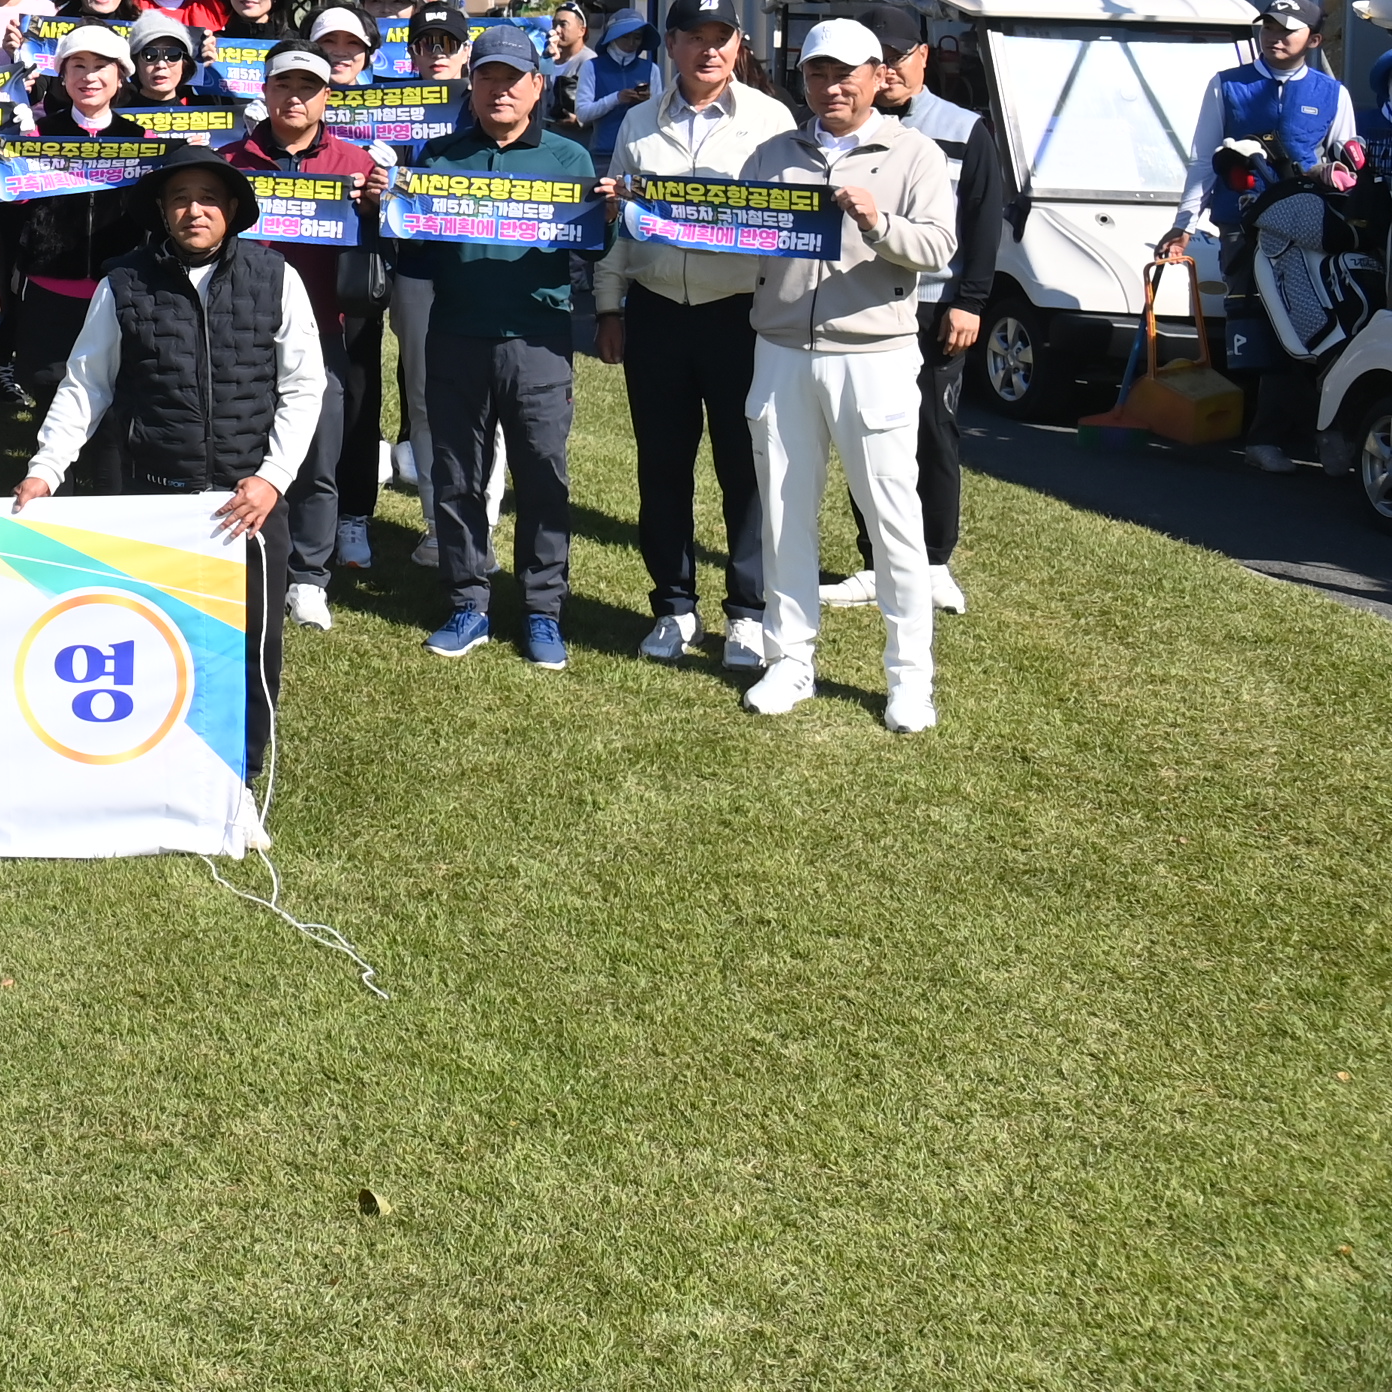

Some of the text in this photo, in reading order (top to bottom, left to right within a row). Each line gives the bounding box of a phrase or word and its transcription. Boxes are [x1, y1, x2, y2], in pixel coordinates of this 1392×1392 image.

[355, 107, 425, 122] 국가철도망
[3, 141, 166, 158] 사천우주항공철도!
[408, 172, 581, 204] 사천우주항공철도!
[645, 178, 820, 213] 사천우주항공철도!
[431, 196, 554, 220] 제5차 국가철도망
[670, 203, 793, 228] 제5차 국가철도망
[262, 217, 344, 238] 반영하라!
[402, 212, 582, 244] 구축계획에 반영하라!
[643, 218, 822, 253] 구축계획에 반영하라!
[147, 474, 167, 486] ELLE
[54, 638, 136, 724] 영
